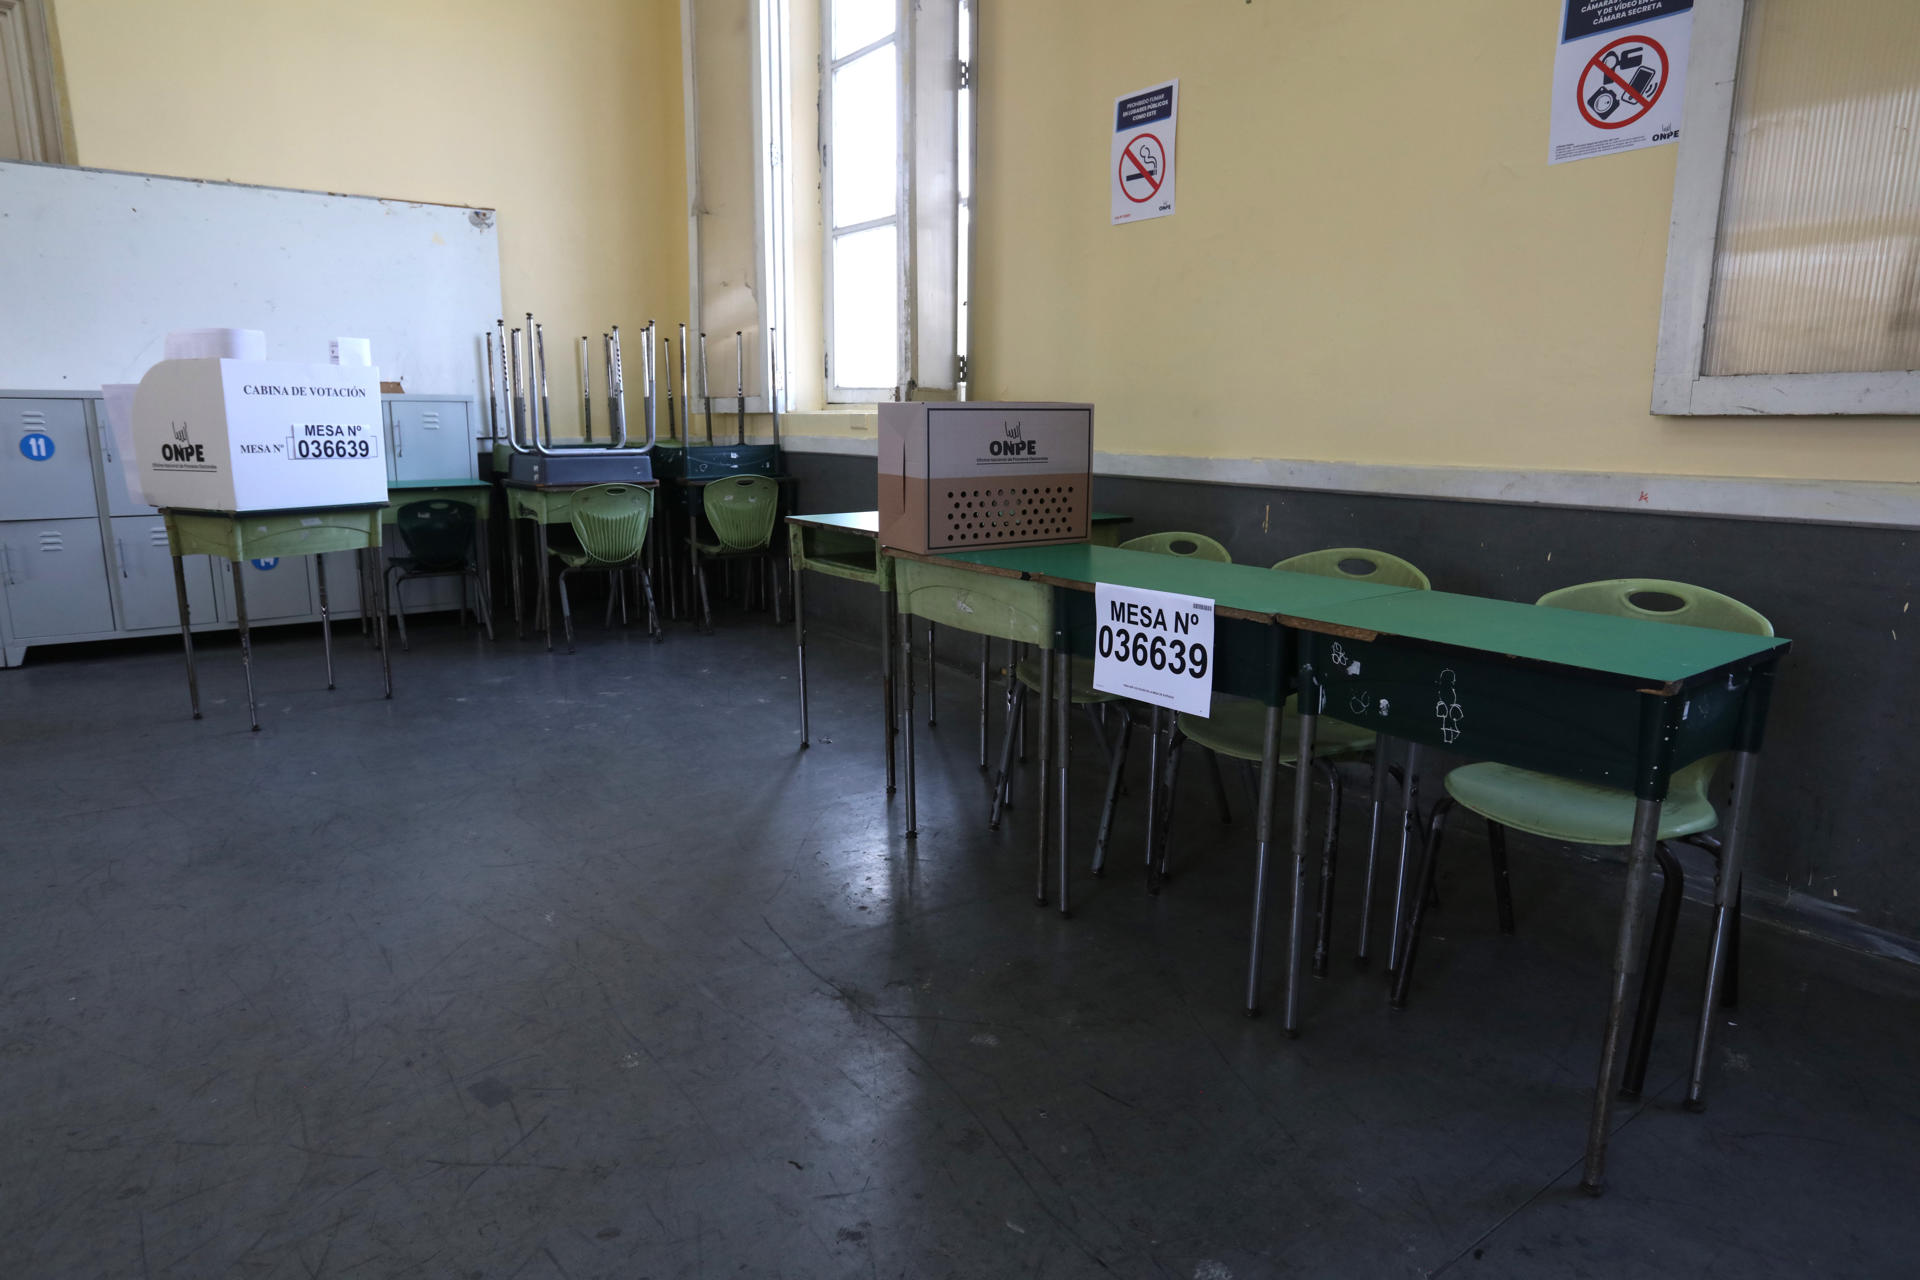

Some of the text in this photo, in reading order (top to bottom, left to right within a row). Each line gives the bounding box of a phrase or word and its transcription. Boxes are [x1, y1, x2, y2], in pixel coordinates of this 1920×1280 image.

[1593, 2, 1662, 25] CÁMARA SECRETA
[1603, 7, 1613, 15] DE
[1614, 1, 1637, 11] VÍDEO
[1652, 129, 1680, 142] ONPE
[243, 384, 366, 398] CABINA DE VOTACIÓN
[304, 424, 345, 437] MESA
[29, 437, 47, 457] 11
[161, 443, 205, 462] ONPE
[240, 444, 272, 454] MESA
[298, 439, 370, 459] 036639
[989, 440, 1037, 456] ONPE
[1110, 600, 1168, 632] MESA
[1098, 625, 1208, 679] 036639
